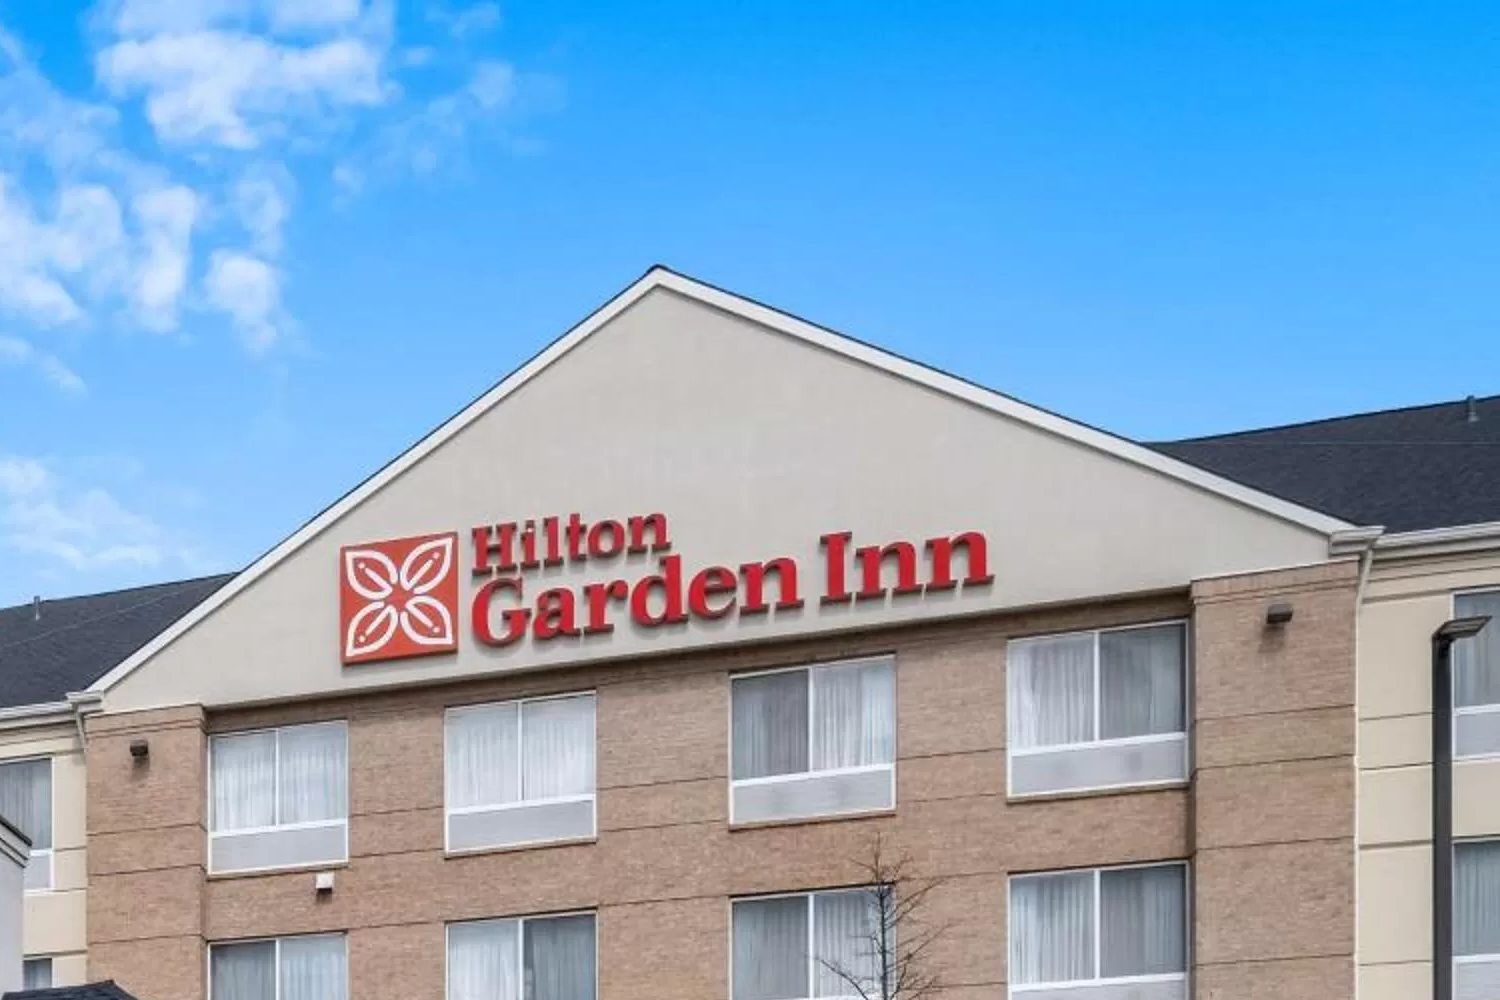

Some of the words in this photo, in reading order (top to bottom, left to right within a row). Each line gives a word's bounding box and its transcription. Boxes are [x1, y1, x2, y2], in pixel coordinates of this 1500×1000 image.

[471, 512, 671, 575] Hilton
[471, 553, 804, 647] Garden
[820, 531, 995, 606] Inn
